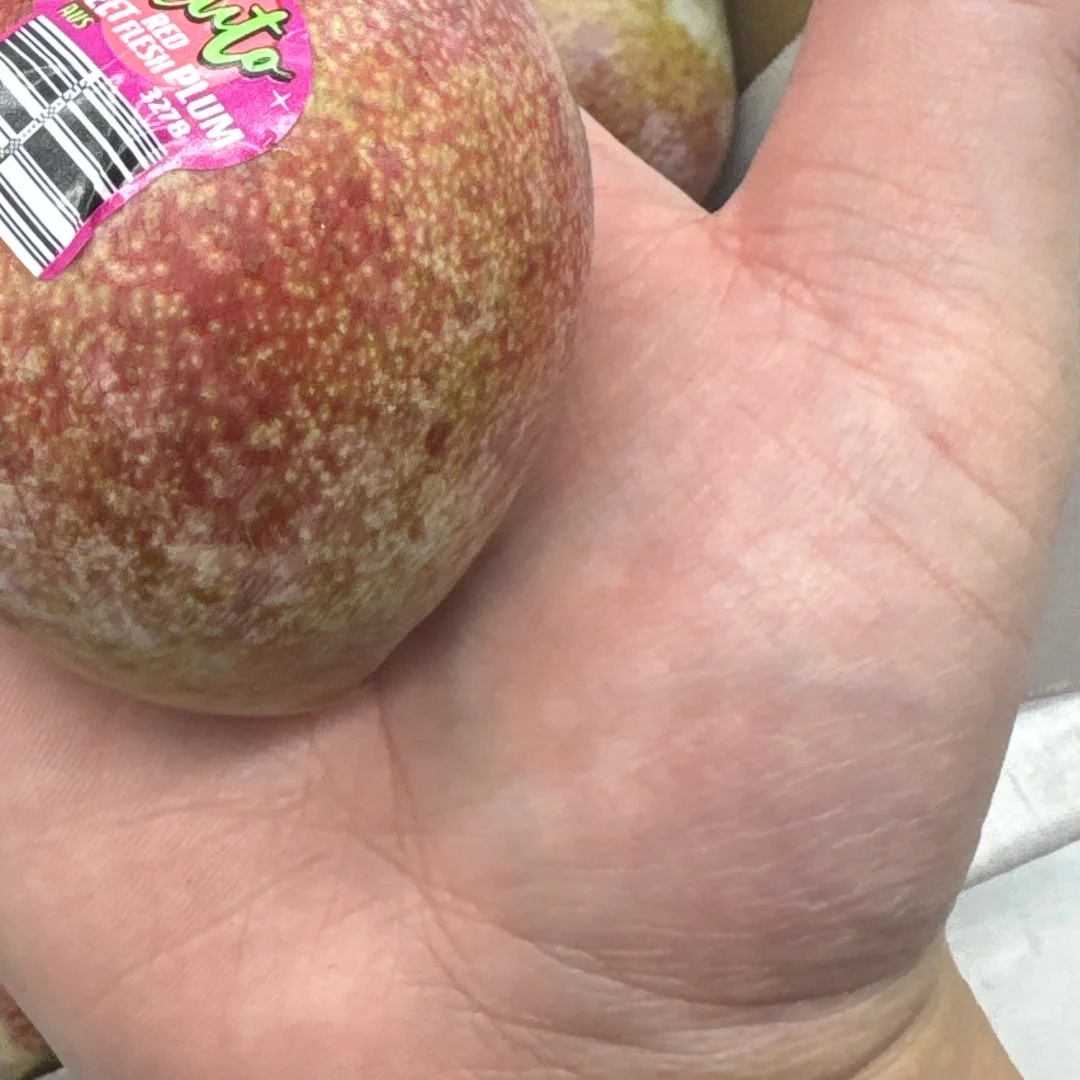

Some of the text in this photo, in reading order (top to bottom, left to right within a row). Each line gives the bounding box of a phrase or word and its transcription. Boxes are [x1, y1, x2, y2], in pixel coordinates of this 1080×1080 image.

[58, 3, 96, 31] AUS
[144, 12, 189, 51] RED
[113, 20, 172, 74] FLESH
[162, 63, 245, 148] PLUM
[139, 86, 191, 138] 3278
